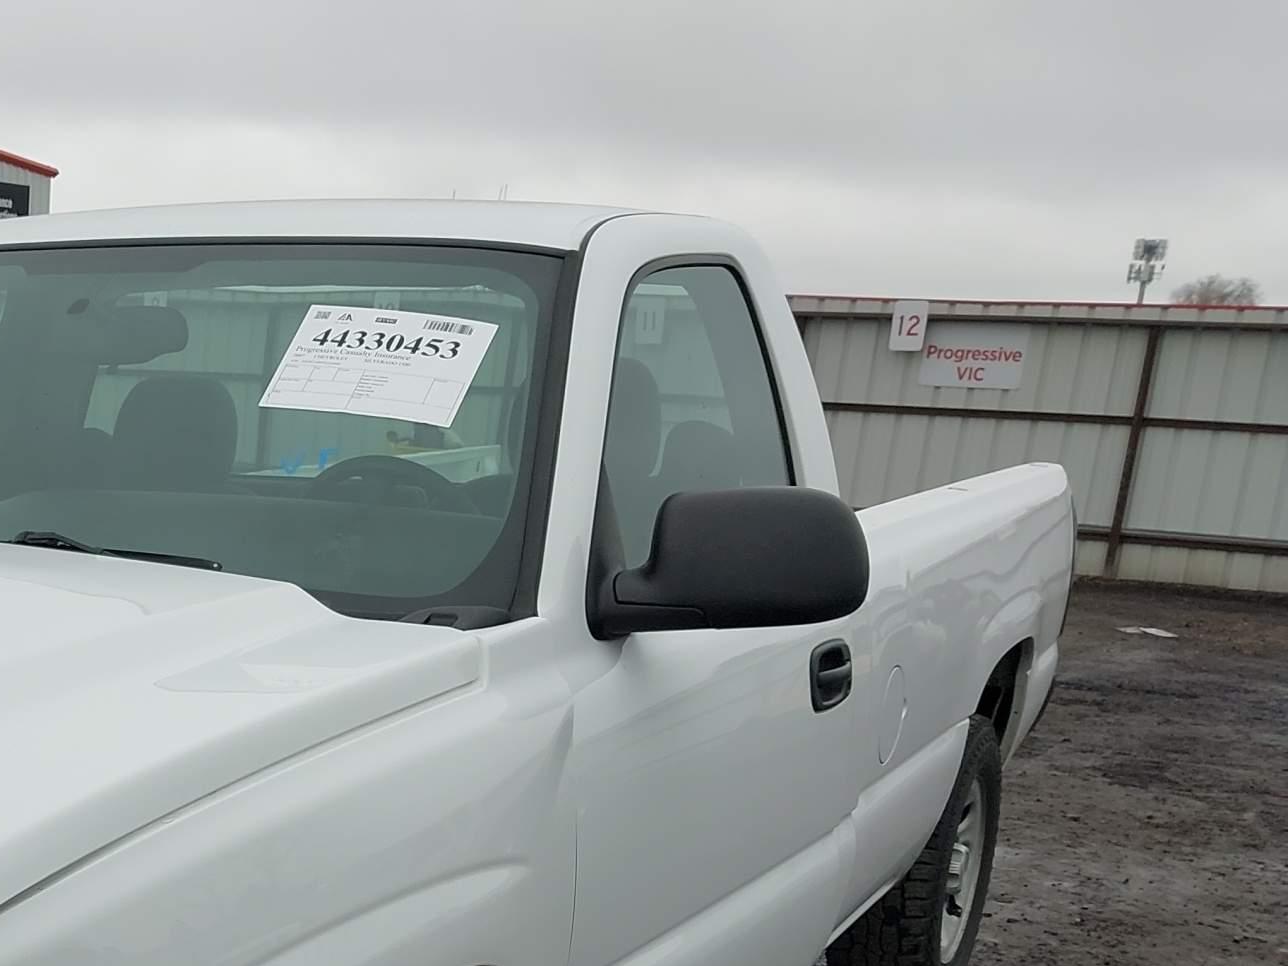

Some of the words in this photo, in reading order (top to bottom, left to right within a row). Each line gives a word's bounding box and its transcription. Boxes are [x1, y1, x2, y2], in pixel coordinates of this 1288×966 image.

[642, 311, 656, 331] 11
[898, 314, 921, 337] 12
[295, 345, 338, 355] Progressive
[339, 348, 372, 359] Casualty
[374, 351, 413, 362] Insurance
[312, 328, 462, 360] 44330453
[926, 345, 1023, 363] Progressive
[956, 366, 985, 382] VIC
